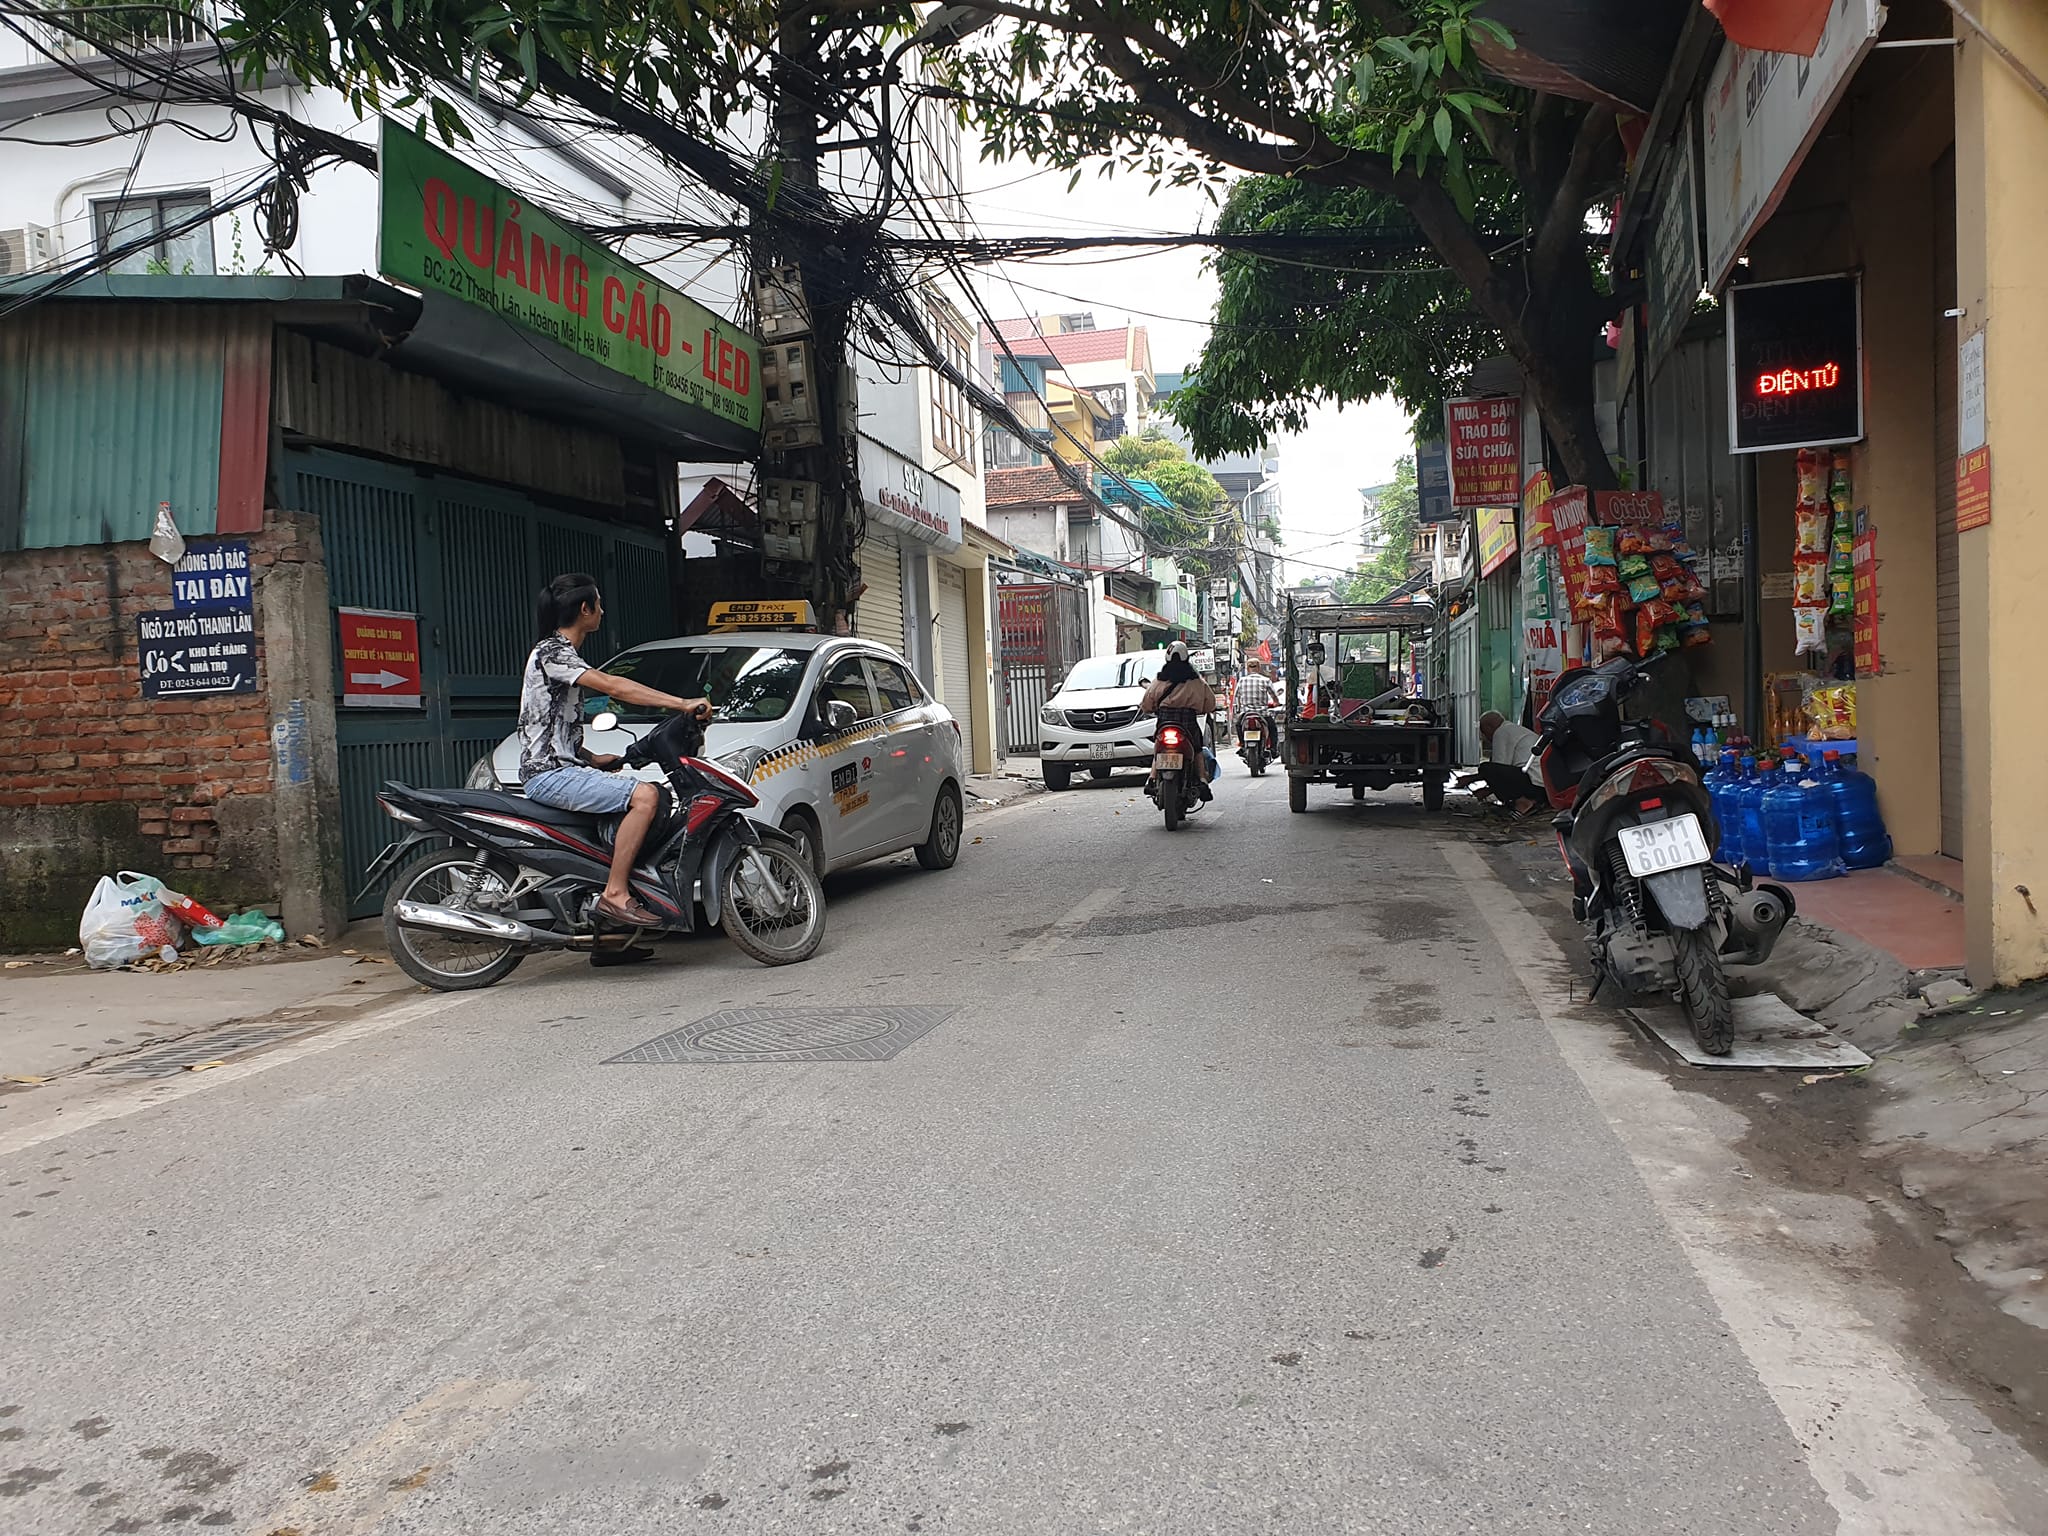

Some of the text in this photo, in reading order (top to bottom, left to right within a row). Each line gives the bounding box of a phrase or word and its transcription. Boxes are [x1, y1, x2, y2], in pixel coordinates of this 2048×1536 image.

[423, 177, 589, 319] QUẢNG
[603, 276, 671, 357] CÁO
[703, 329, 750, 397] LED
[423, 255, 446, 285] ĐC:
[449, 269, 463, 293] 22
[467, 275, 499, 307] Thanh
[502, 291, 520, 319] Lân
[529, 304, 559, 340] Hoàng
[561, 320, 577, 344] Mai
[583, 330, 595, 353] Hà
[596, 336, 610, 363] Nội
[1759, 362, 1838, 394] ĐIỆN TỬ
[1454, 405, 1479, 421] MUA
[1491, 400, 1515, 419] BÁN
[1459, 420, 1511, 440] TRAO ĐỔI
[1456, 441, 1515, 460] SỬA CHỮA
[1609, 496, 1650, 520] Oishi
[209, 546, 223, 571] ĐỔ
[225, 548, 246, 569] RÁC
[175, 573, 248, 604] TẠI ĐÂY
[141, 611, 252, 640] NGÕ 22 PHỐ THANH LÂN
[748, 614, 759, 622] 25
[760, 614, 772, 622] 25
[773, 613, 785, 622] 25
[145, 650, 169, 673] Có
[188, 647, 207, 658] KHO
[222, 643, 247, 656] HÀNG
[190, 661, 228, 673] NHÀ TRỌ
[175, 678, 194, 688] 0243
[211, 676, 230, 685] 0423
[1631, 819, 1689, 850] 30-Y1
[1638, 841, 1697, 871] 6001
